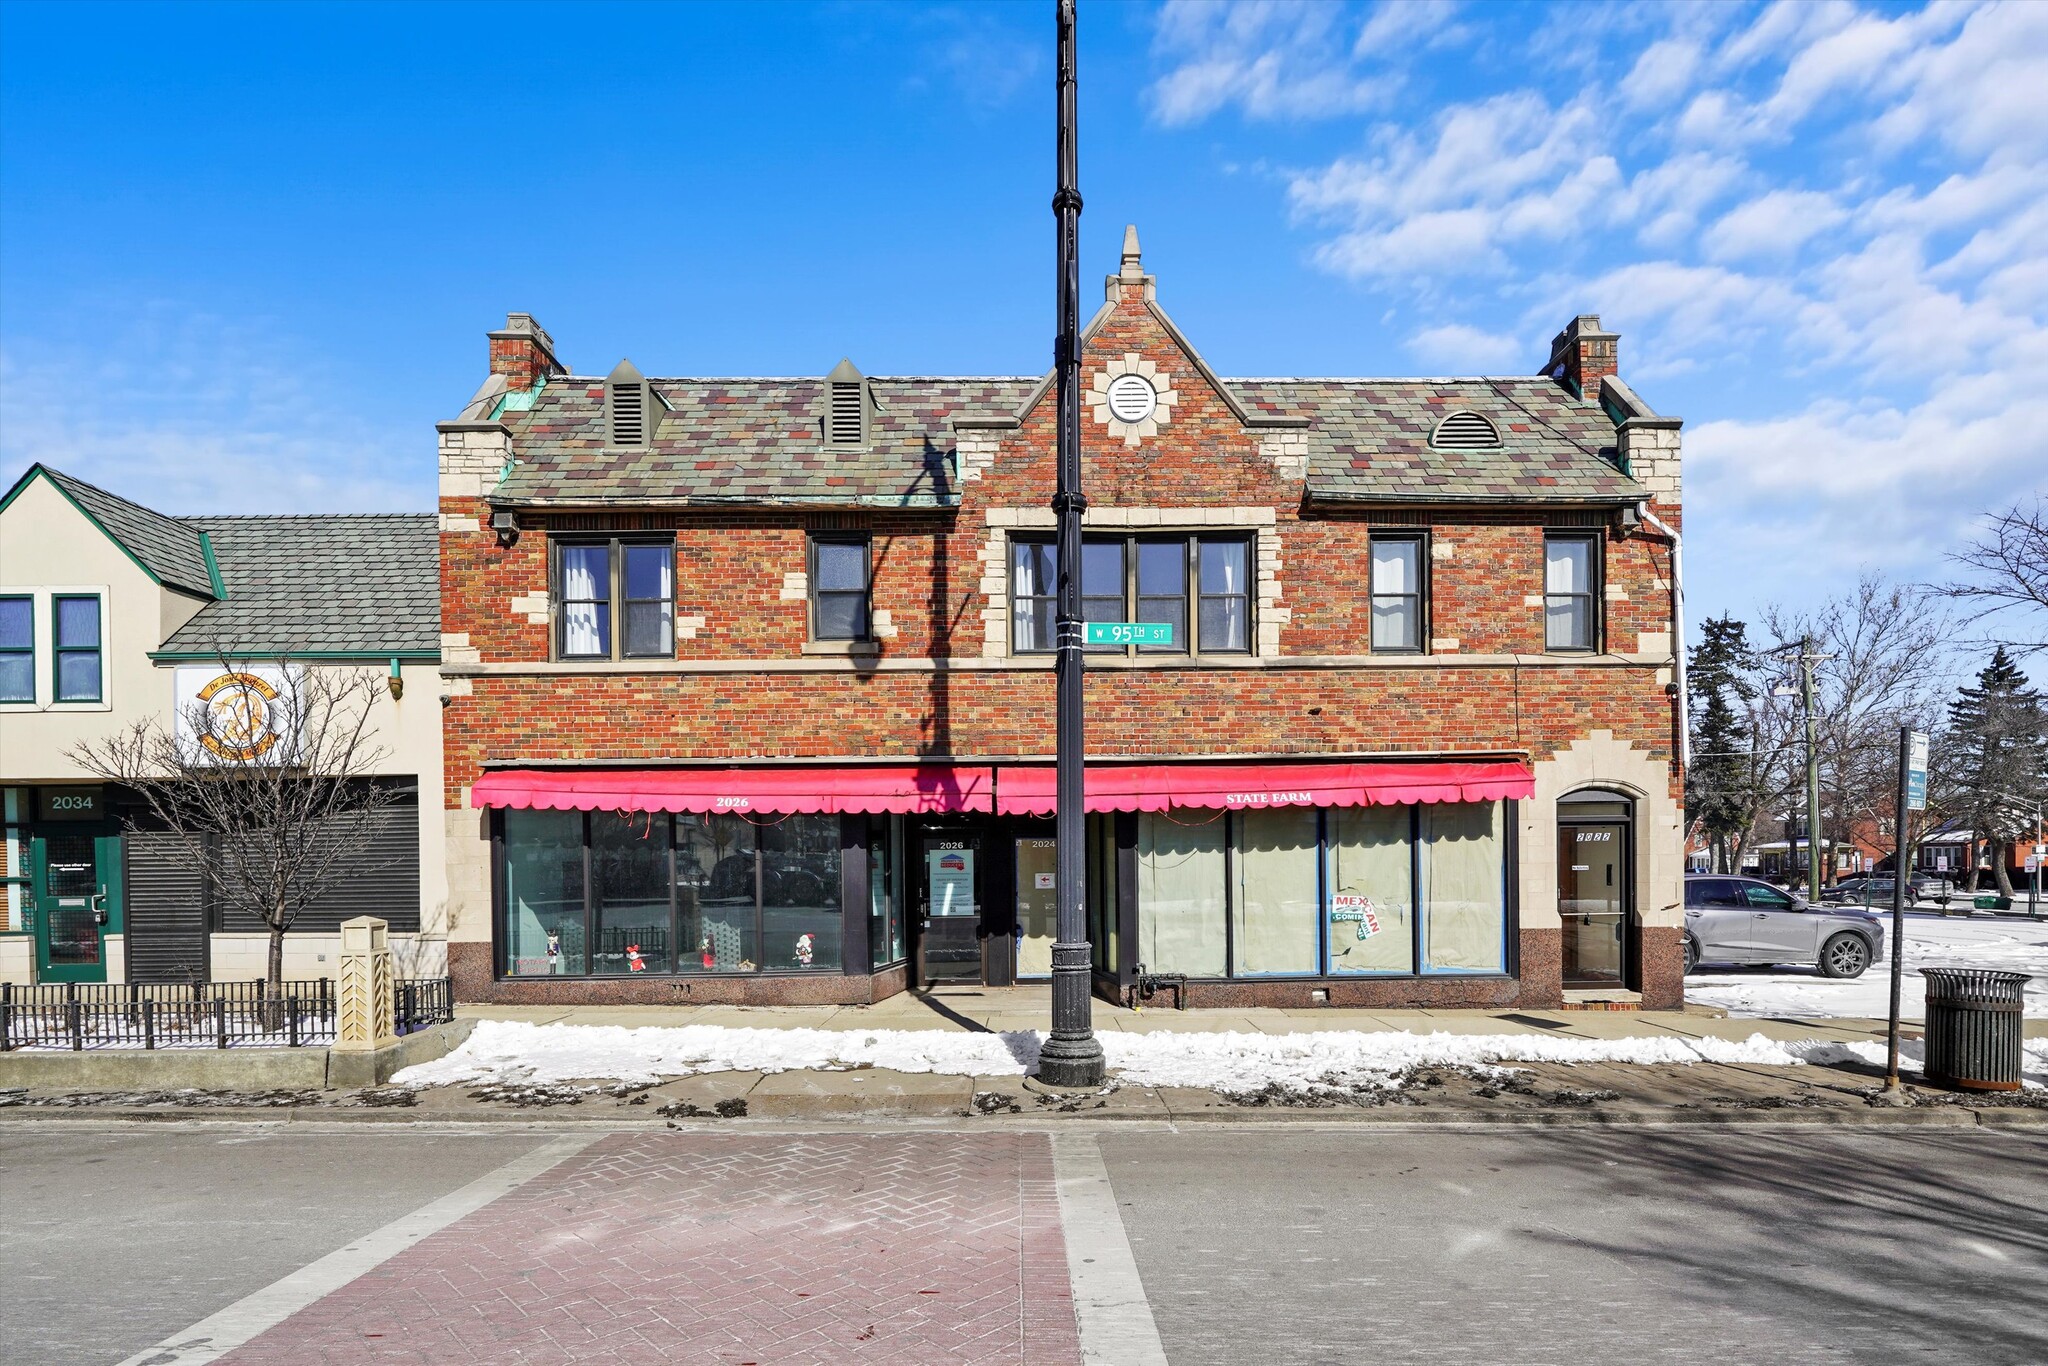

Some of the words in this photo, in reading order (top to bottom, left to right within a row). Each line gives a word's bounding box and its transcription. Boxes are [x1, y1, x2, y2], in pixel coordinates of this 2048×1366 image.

[1095, 628, 1104, 639] W
[1111, 626, 1145, 641] 95TH
[1153, 629, 1165, 639] ST
[209, 682, 219, 691] De
[52, 796, 93, 809] 2034
[716, 797, 749, 807] 2026
[1226, 793, 1269, 804] STATE
[1272, 792, 1312, 802] FARM
[1576, 832, 1611, 841] 2022
[1032, 840, 1055, 848] 2024
